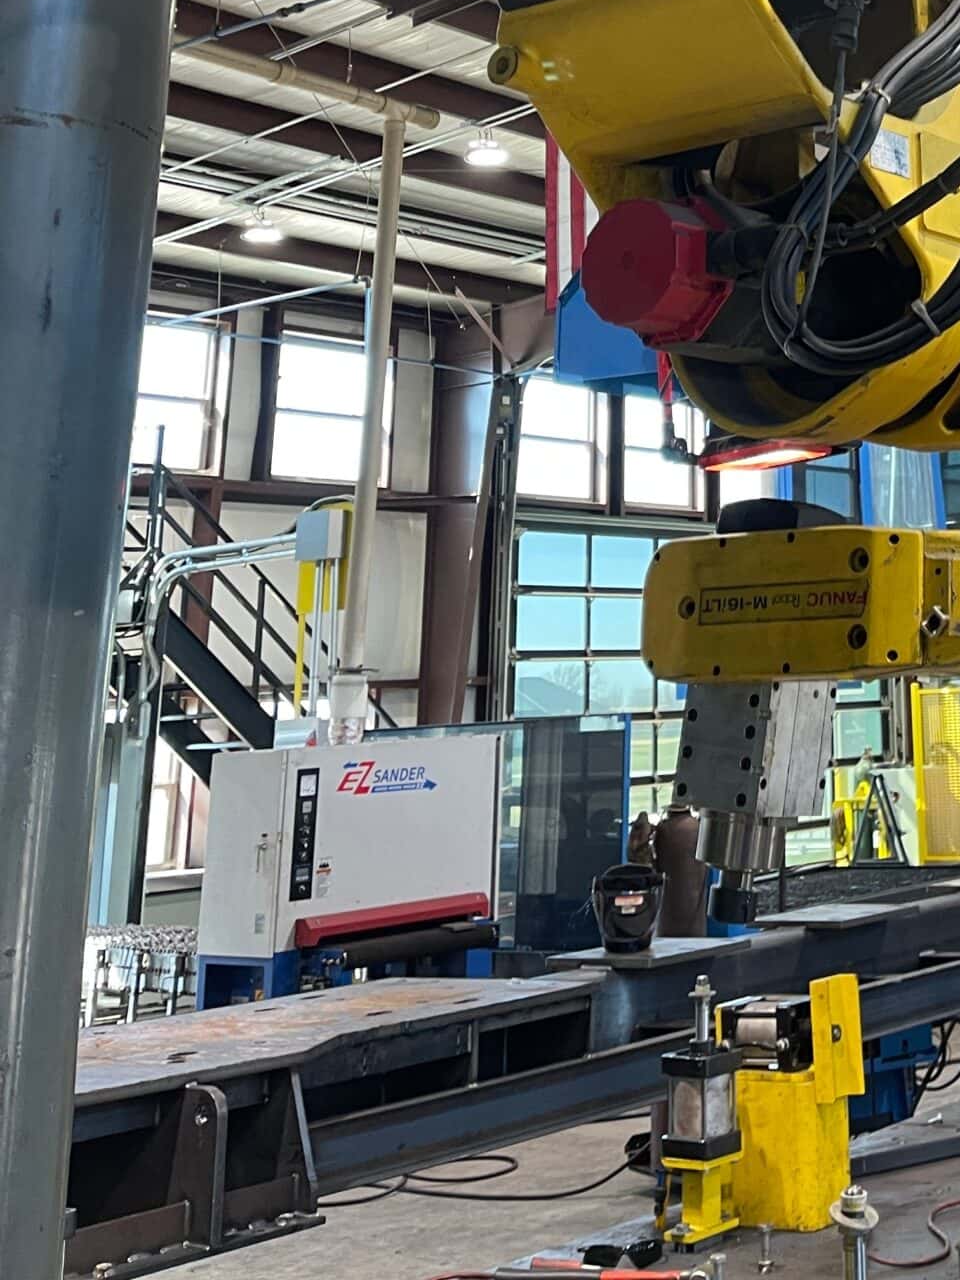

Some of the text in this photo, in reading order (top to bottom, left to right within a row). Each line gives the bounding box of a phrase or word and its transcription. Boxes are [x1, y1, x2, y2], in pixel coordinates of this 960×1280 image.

[805, 590, 868, 608] FANUC
[336, 761, 376, 794] EZ
[373, 766, 425, 783] SANDER
